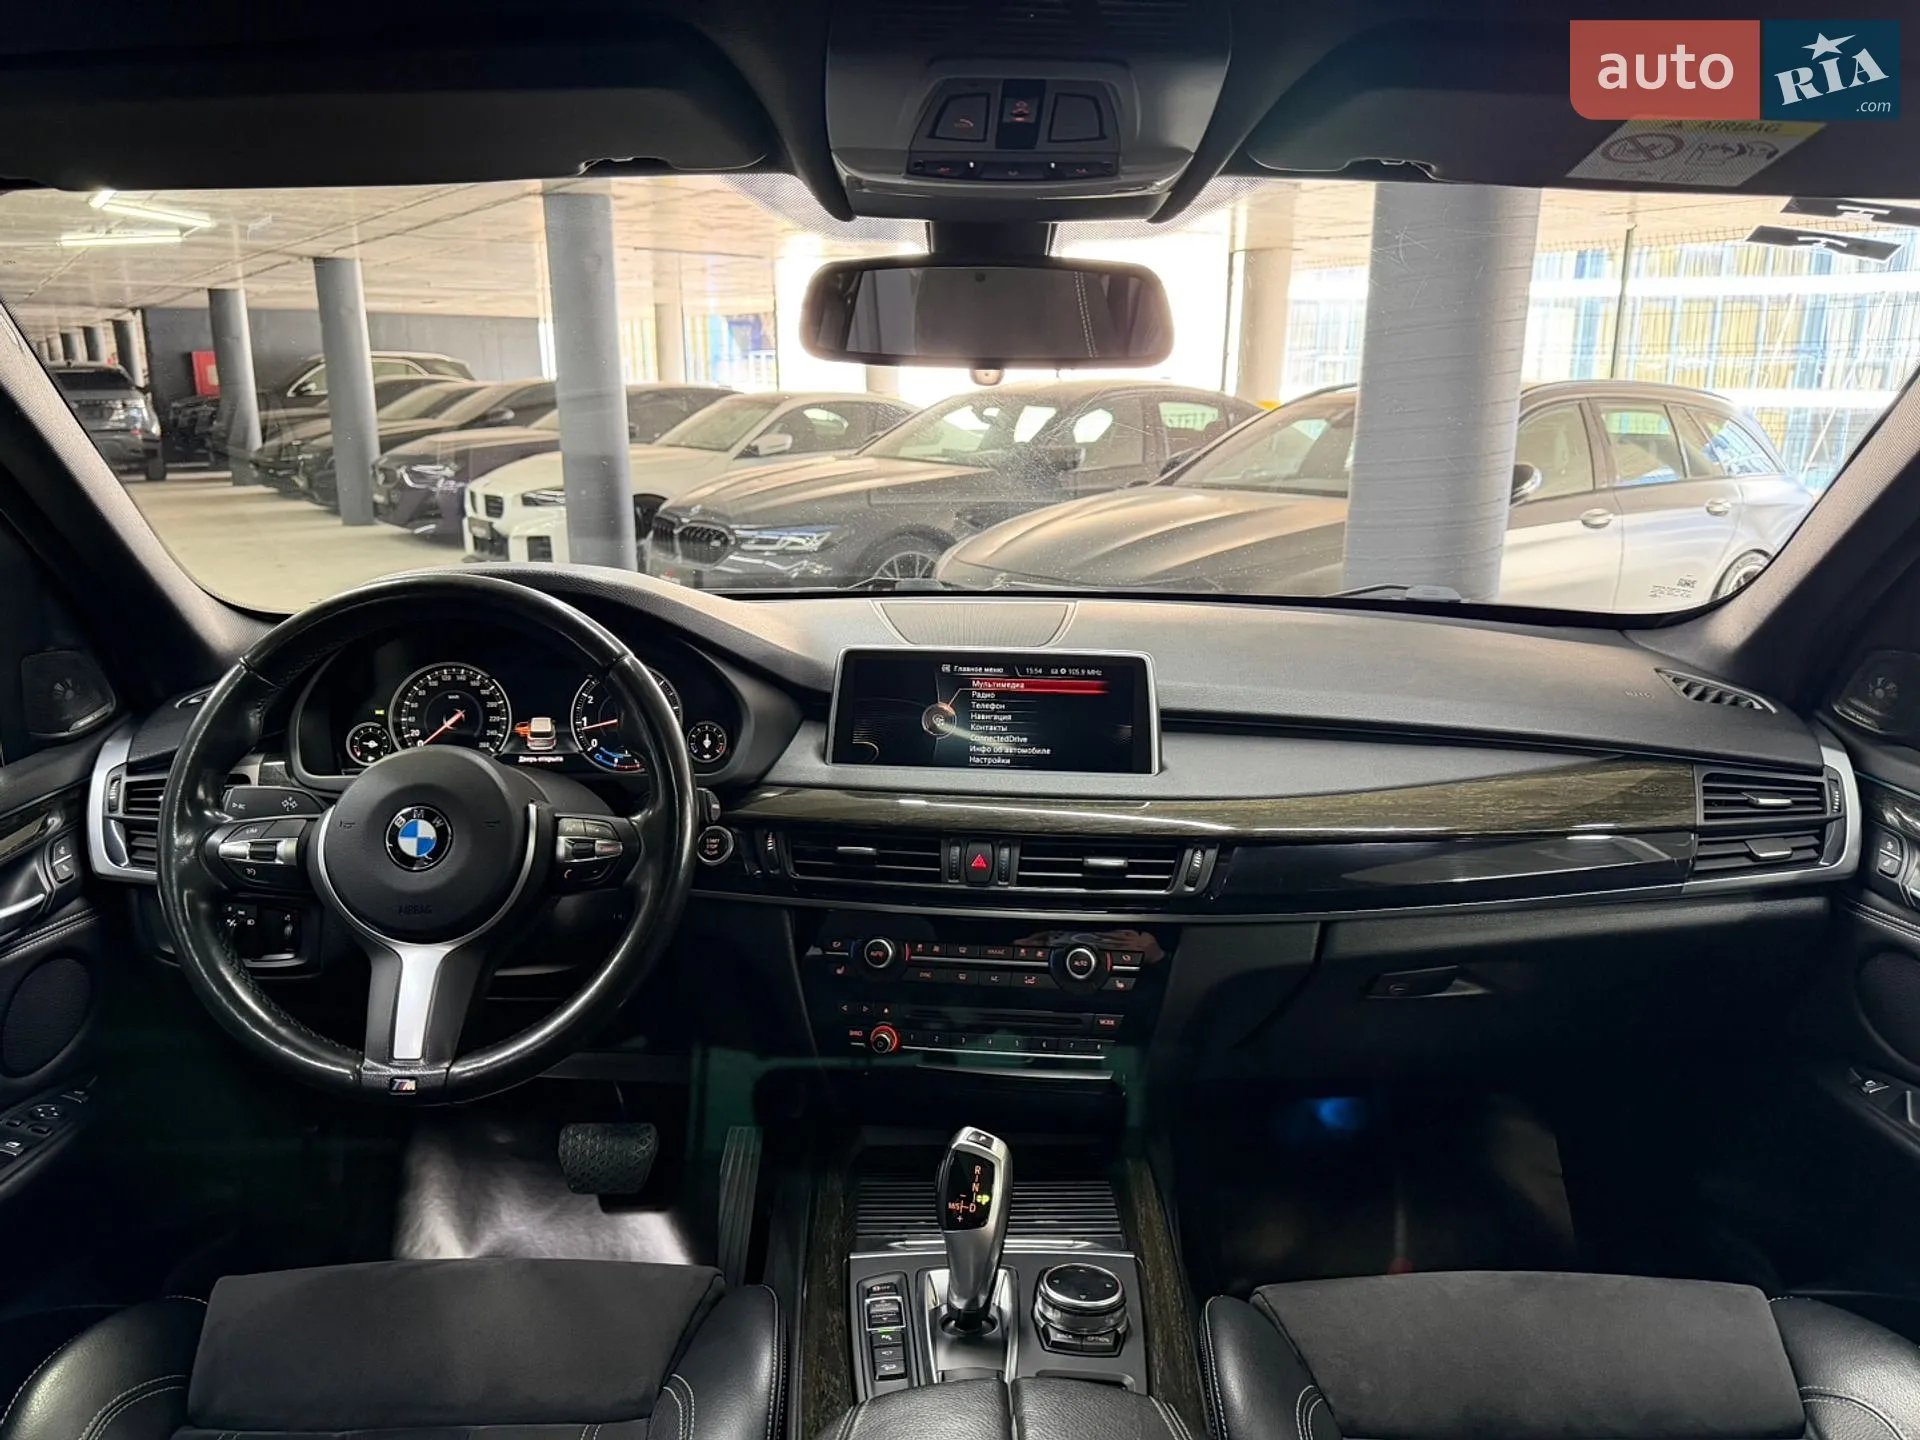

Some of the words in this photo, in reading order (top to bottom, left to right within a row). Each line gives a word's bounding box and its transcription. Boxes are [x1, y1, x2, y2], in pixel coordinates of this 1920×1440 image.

[953, 665, 983, 674] Главное
[971, 680, 1025, 689] Мультимедиа
[971, 690, 996, 699] Радио
[587, 695, 594, 704] 2
[971, 701, 1006, 711] Телефон
[970, 712, 1012, 722] Навигация
[970, 723, 1008, 732] Контакты
[591, 738, 598, 748] 0
[970, 734, 1028, 743] ConnectedDrive
[969, 745, 991, 754] Инфо
[1004, 746, 1051, 755] автомобиле
[969, 756, 1011, 765] Настройки
[394, 809, 444, 829] BMW
[974, 1165, 981, 1174] R
[972, 1183, 980, 1192] N
